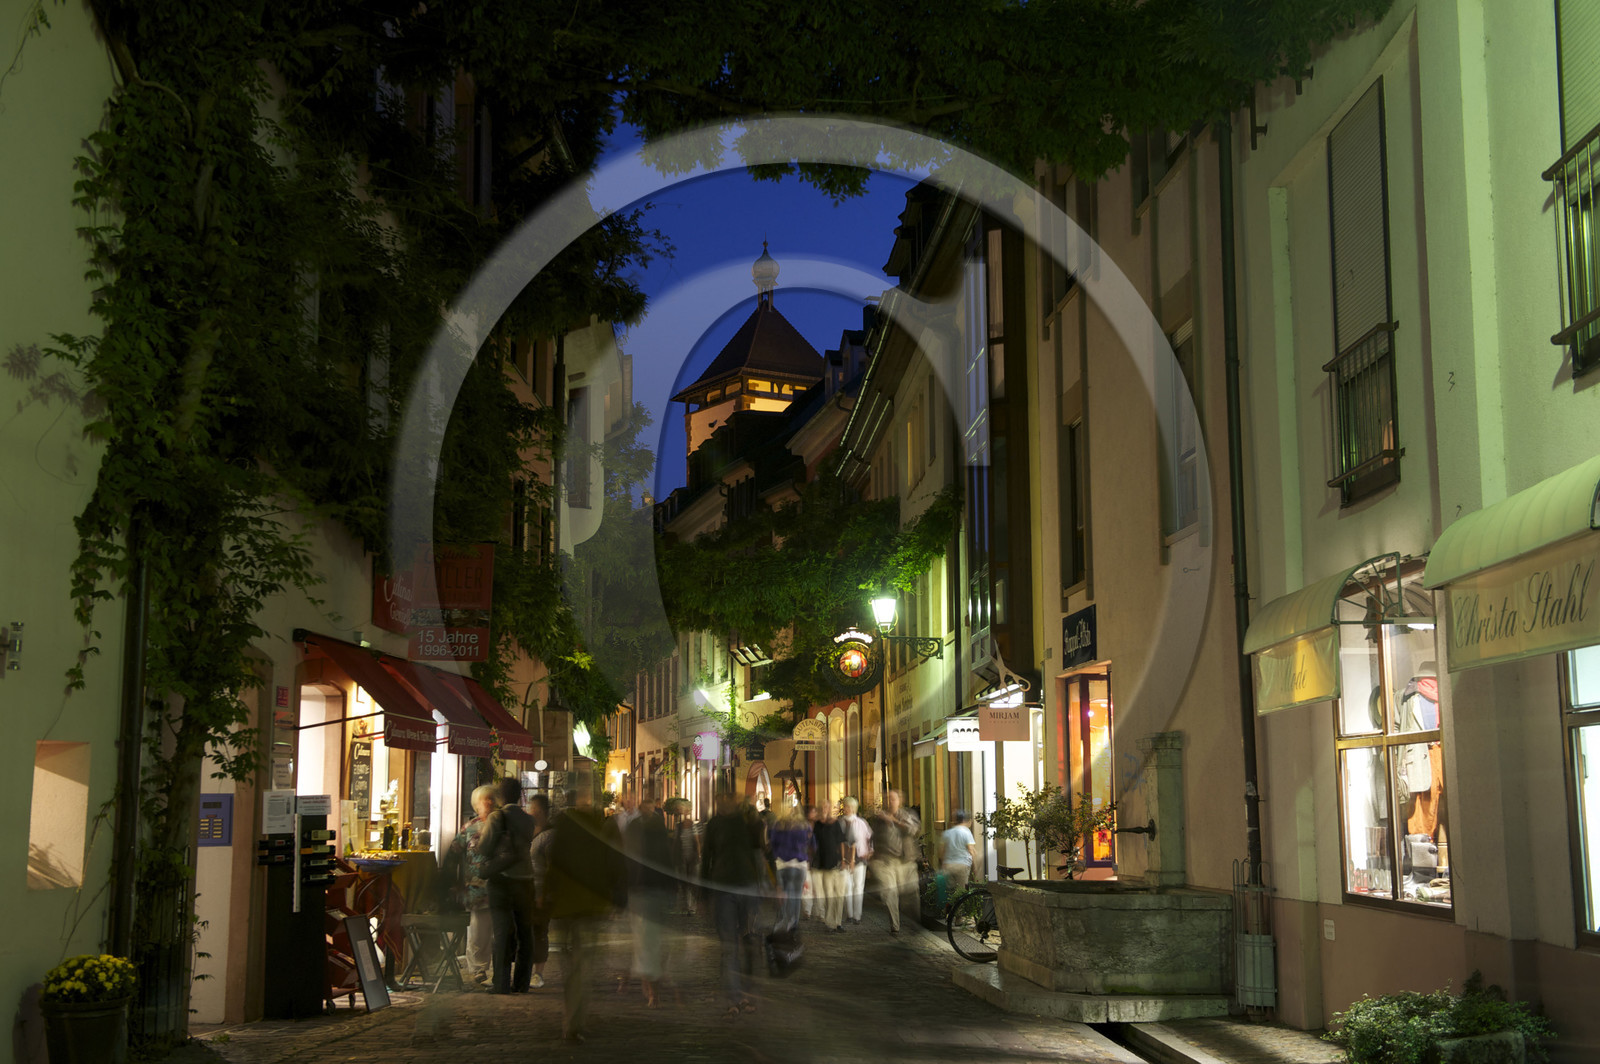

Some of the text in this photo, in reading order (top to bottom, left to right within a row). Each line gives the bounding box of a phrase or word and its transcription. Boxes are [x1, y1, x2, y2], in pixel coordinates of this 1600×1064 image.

[1453, 559, 1595, 648] Christa Stahl
[418, 630, 479, 644] 15 Jahre
[418, 644, 479, 657] 1996-2011
[989, 712, 1019, 720] MIRJAM
[795, 720, 827, 737] GUTENBERG
